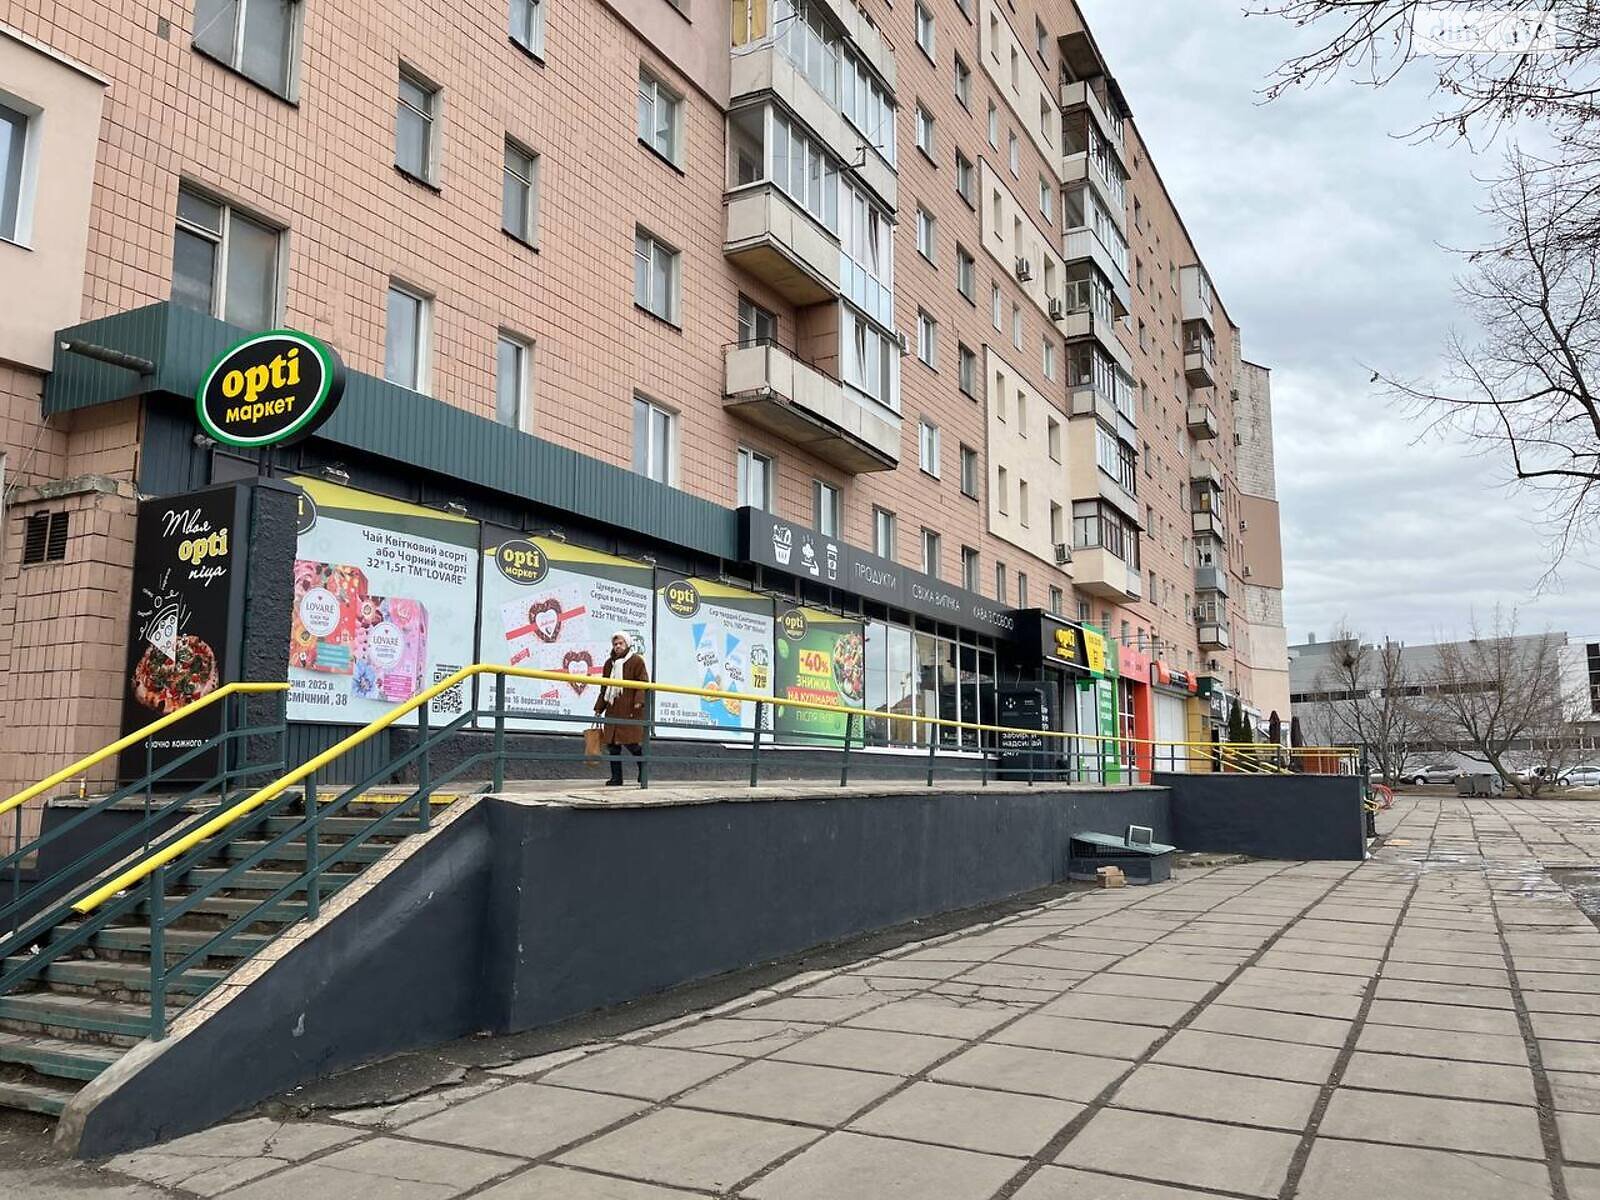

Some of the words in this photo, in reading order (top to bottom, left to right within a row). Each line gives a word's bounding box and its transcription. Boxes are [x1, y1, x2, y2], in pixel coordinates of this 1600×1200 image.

[222, 347, 301, 402] opti
[225, 395, 296, 423] маркет
[178, 527, 228, 565] opti
[362, 530, 383, 544] Чай
[385, 534, 437, 556] Квітковий
[438, 549, 468, 562] асорті
[376, 547, 395, 559] або
[397, 551, 437, 568] Чорний
[438, 562, 467, 575] асорті
[503, 549, 540, 568] opti
[505, 566, 538, 579] маркет
[669, 588, 694, 604] opti
[306, 602, 335, 614] LOVARE
[785, 616, 804, 629] opti
[800, 652, 829, 673] -40%
[308, 679, 328, 690] 2025
[335, 693, 348, 706] 38
